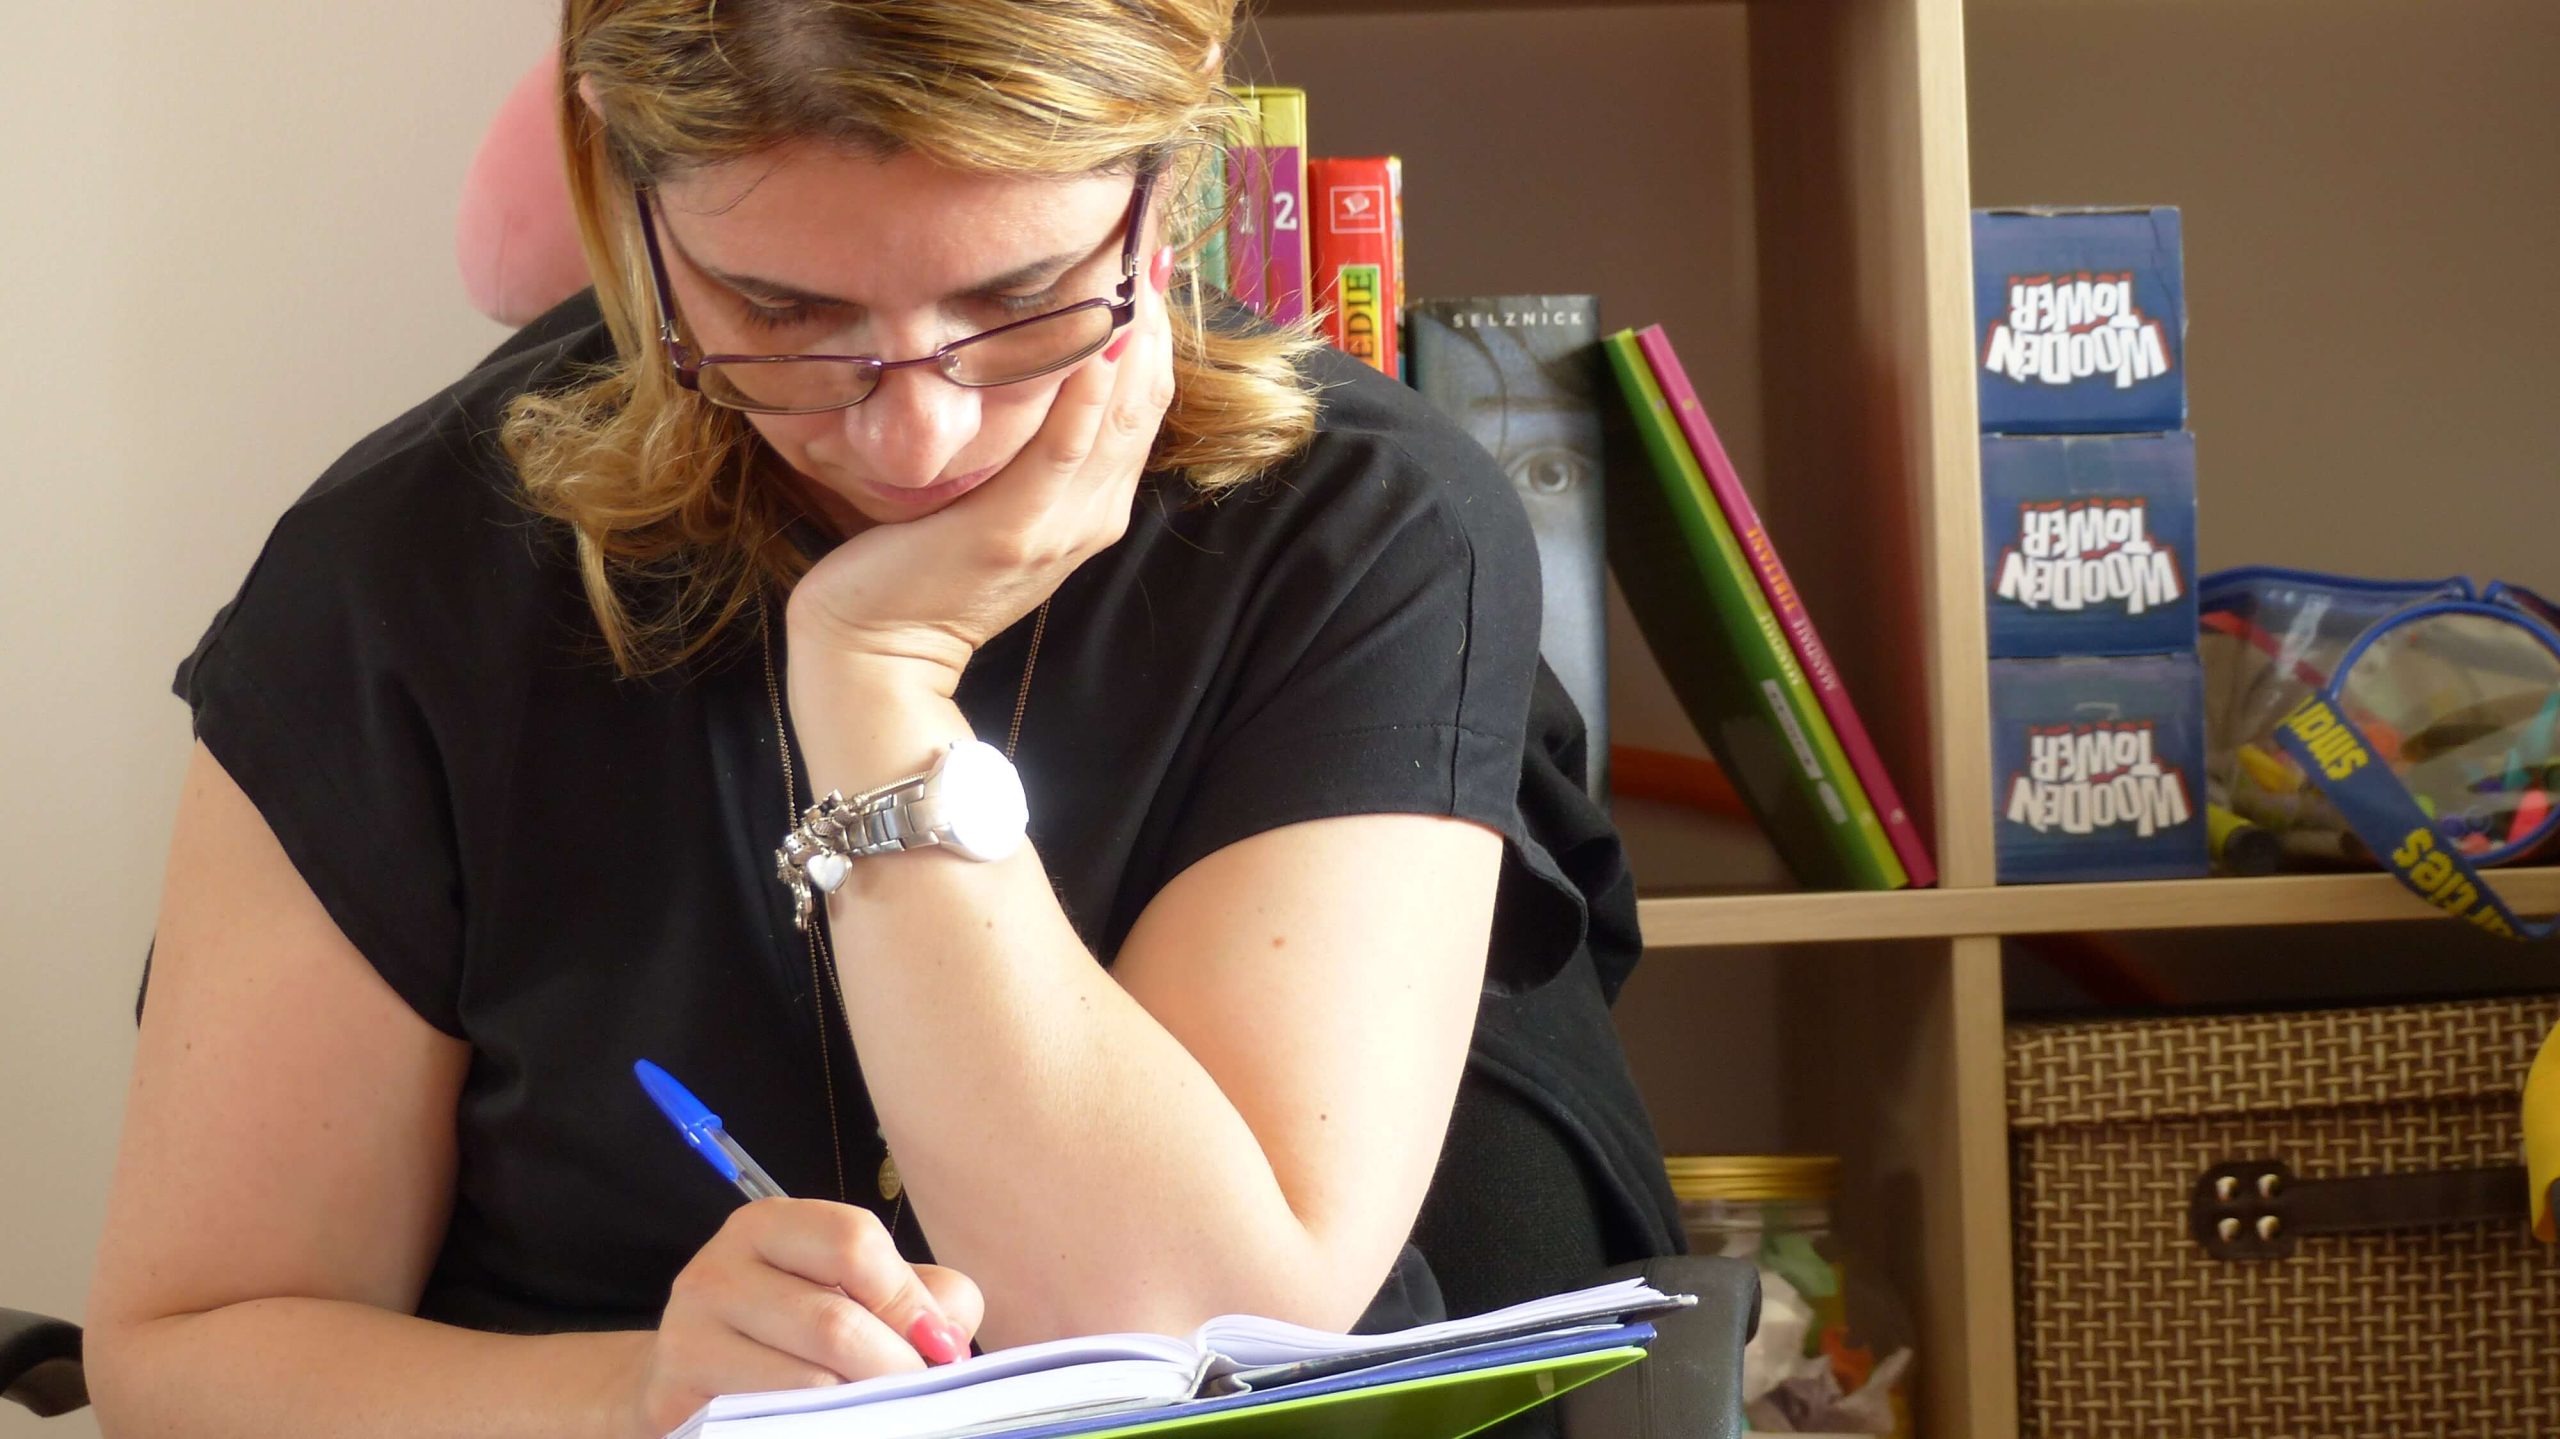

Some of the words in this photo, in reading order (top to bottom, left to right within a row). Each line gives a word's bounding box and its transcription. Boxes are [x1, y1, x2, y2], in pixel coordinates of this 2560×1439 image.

[1272, 191, 1298, 231] 2
[1452, 310, 1583, 329] SELZNICK
[2010, 279, 2142, 334] TOWER
[1985, 323, 2168, 389] WOODEN
[2022, 506, 2153, 561] TOWER
[1997, 550, 2180, 614] WOODEN
[2030, 728, 2161, 784] TOWER
[2006, 772, 2190, 837] WOODEN
